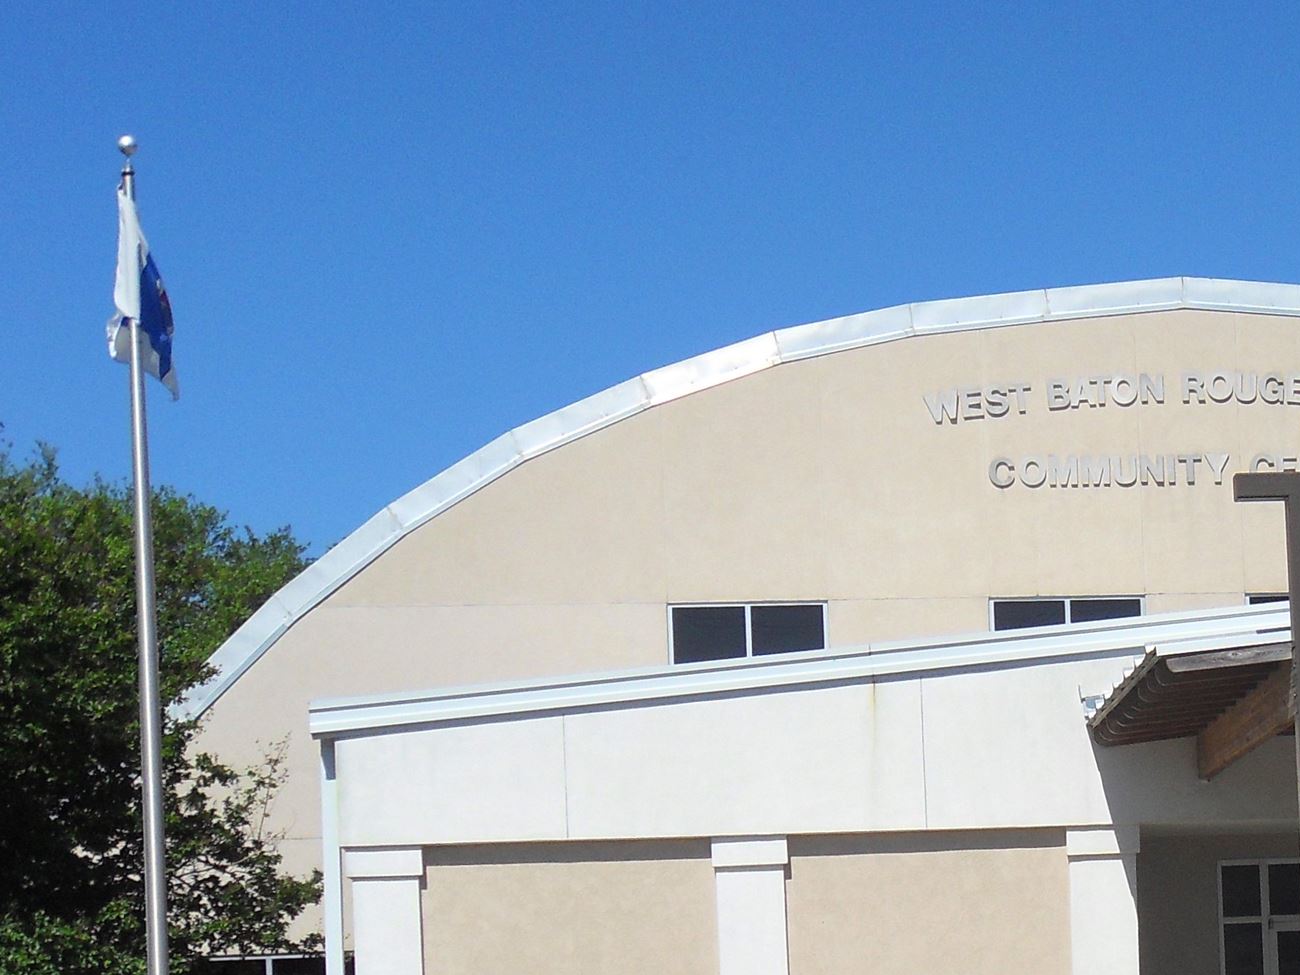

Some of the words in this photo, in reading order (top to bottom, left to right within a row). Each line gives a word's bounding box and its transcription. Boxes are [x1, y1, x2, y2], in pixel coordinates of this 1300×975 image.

[922, 384, 1032, 425] WEST
[1045, 374, 1166, 413] BATON
[988, 453, 1230, 489] COMMUNITY
